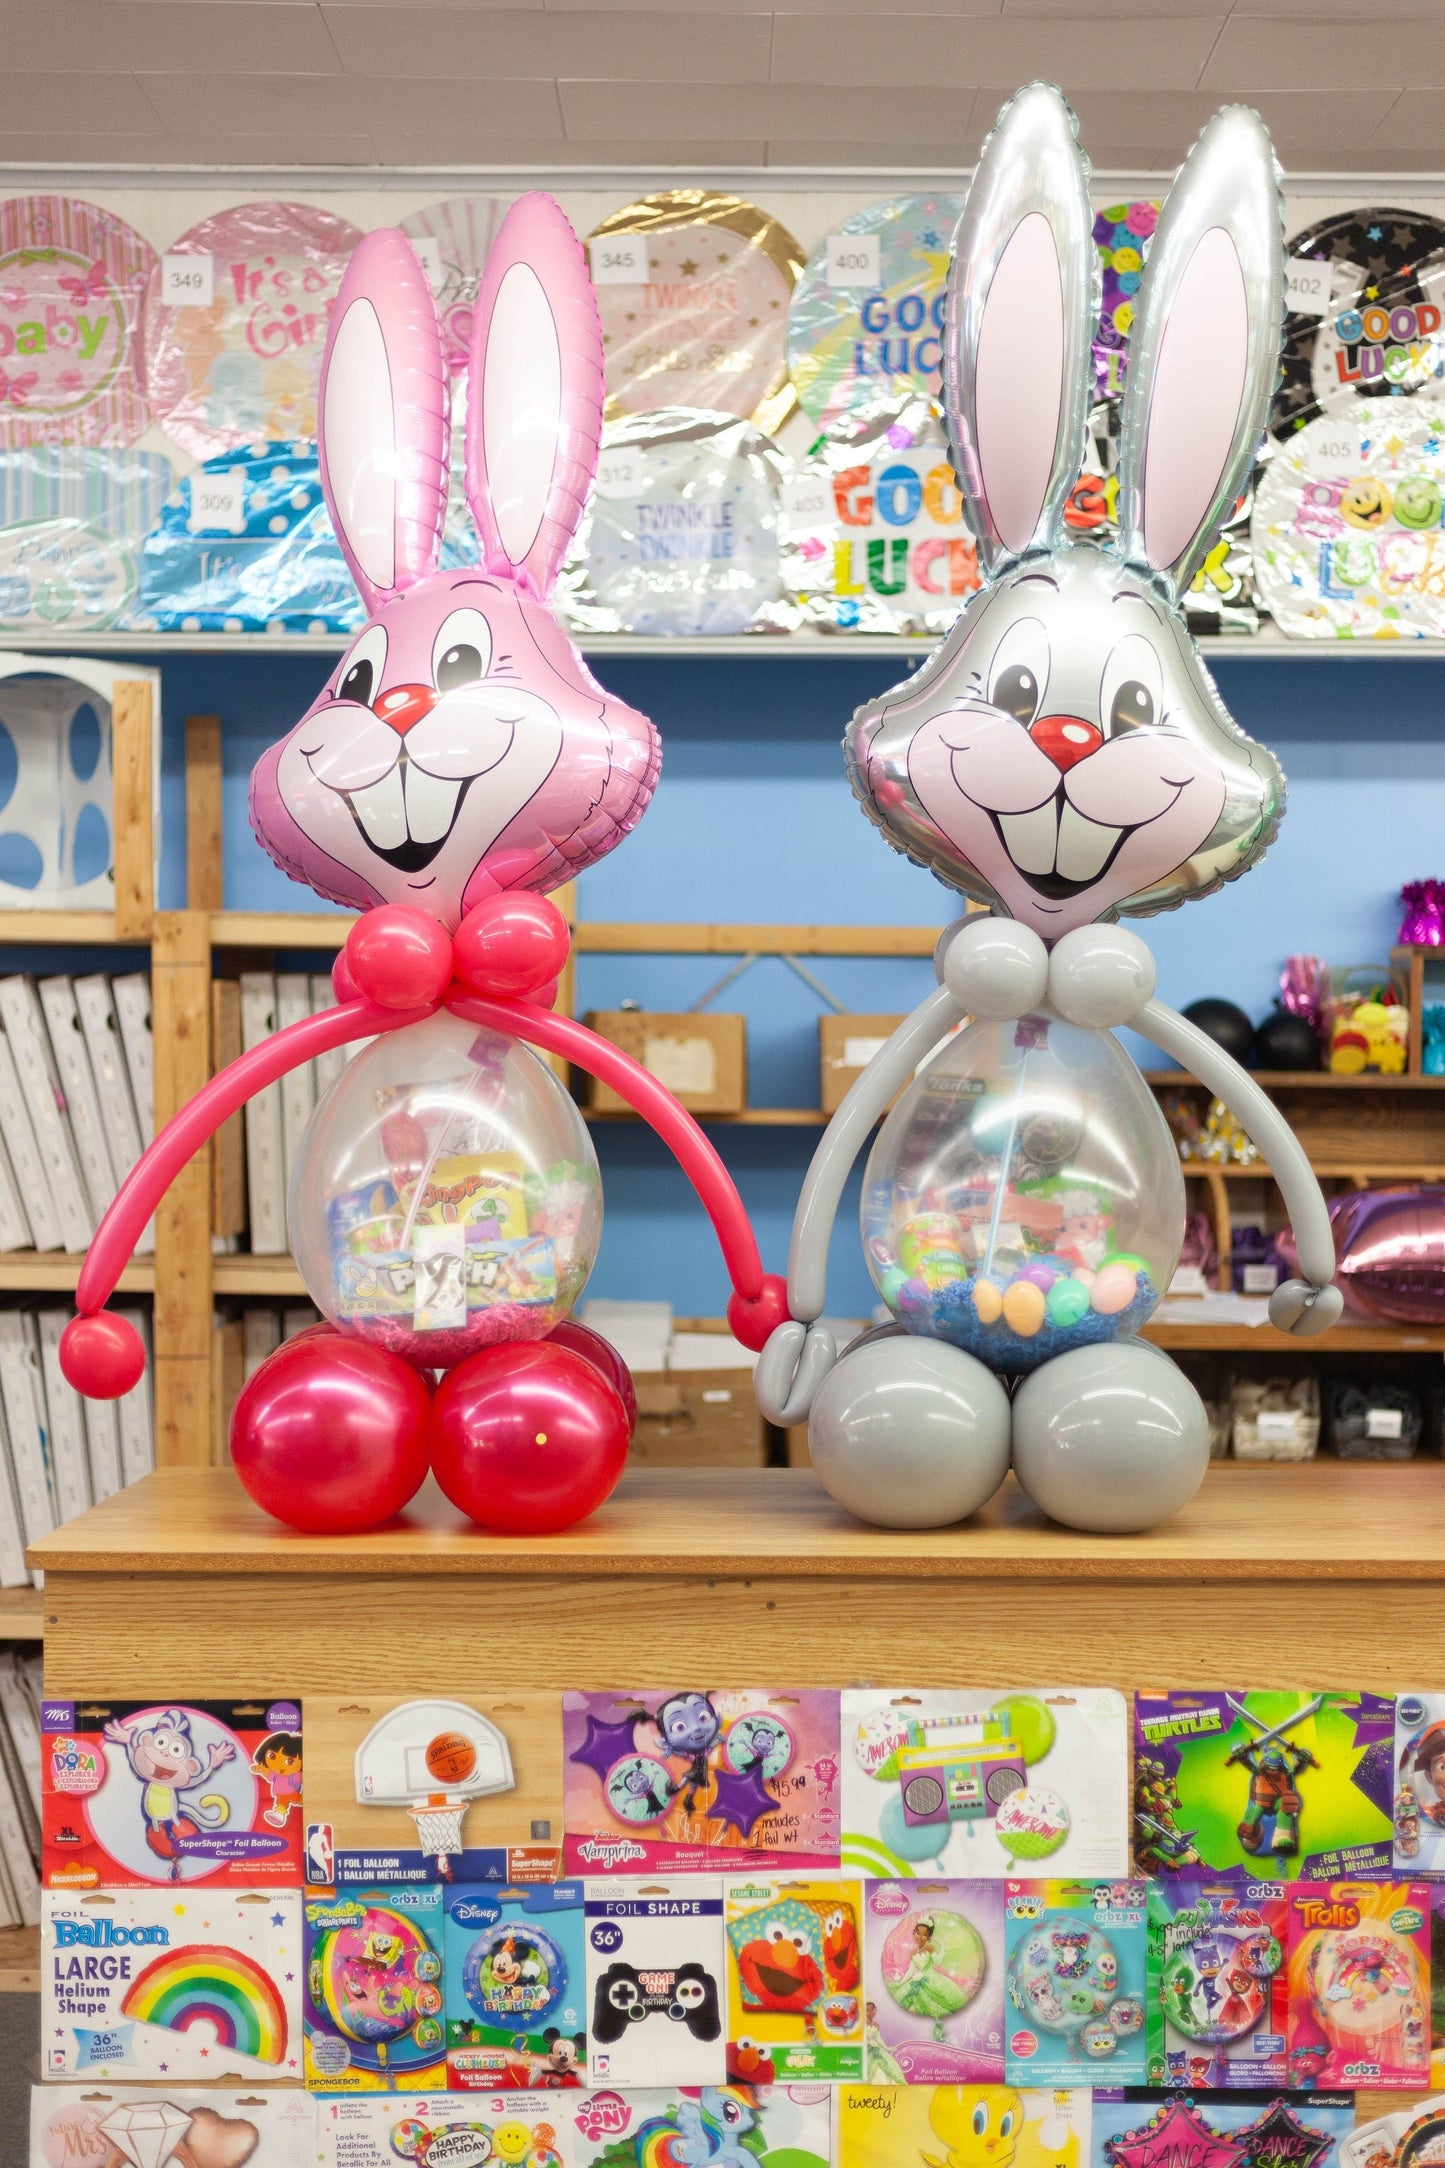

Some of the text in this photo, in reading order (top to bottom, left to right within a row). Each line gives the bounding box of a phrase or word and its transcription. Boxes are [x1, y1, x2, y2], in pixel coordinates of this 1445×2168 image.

[601, 252, 635, 269] 345
[834, 253, 869, 271] 400
[170, 272, 203, 289] 349
[230, 256, 293, 305] It's
[1289, 277, 1322, 295] 402
[1335, 304, 1442, 342] GOOD
[1319, 442, 1351, 458] 405
[600, 466, 633, 483] 312
[199, 494, 232, 512] 309
[270, 1712, 298, 1720] Balloon
[1141, 1715, 1222, 1741] TURTLES
[430, 1739, 467, 1760] SPALDING
[761, 1813, 800, 1829] includes
[1004, 1809, 1061, 1840] AWESOME
[234, 1839, 282, 1848] Foil Balloon
[578, 1843, 646, 1868] Vampirina
[675, 1851, 705, 1859] Bouquet
[1341, 1847, 1376, 1862] BALLOON
[343, 1859, 361, 1868] FOIL
[363, 1858, 399, 1868] BALLOON
[311, 1870, 325, 1881] NBA
[343, 1871, 374, 1880] BALLON
[376, 1868, 427, 1880] MÉTALLIQUE
[390, 1892, 438, 1905] orbz XL
[731, 1889, 771, 1898] SESAME STREET
[1247, 1883, 1285, 1898] orbz
[606, 1902, 701, 1915] FOIL SHAPE
[873, 1898, 909, 1912] Disney
[1008, 1897, 1044, 1908] BEANIE
[457, 1905, 499, 1923] Disney
[1127, 1911, 1142, 1922] XL
[1173, 1909, 1199, 1928] PJ
[1293, 1901, 1358, 1928] Trolls
[51, 1918, 170, 1949] Balloon
[53, 1955, 131, 1981] LARGE
[638, 1972, 676, 1984] GAME
[54, 1983, 111, 1998] Helium
[490, 1985, 544, 2001] HAPPY
[645, 1983, 670, 1995] ON!
[57, 1999, 107, 2018] Shape
[484, 1997, 548, 2012] BIRTHDAY
[89, 2051, 125, 2061] ENCLOSED
[90, 2044, 123, 2054] BALLOON
[1343, 2060, 1381, 2077] orbz
[308, 2079, 361, 2087] SPONGEBOB
[330, 2105, 338, 2120] 1
[415, 2101, 429, 2116] 2
[490, 2098, 505, 2113] 3
[848, 2092, 897, 2118] tweety!
[574, 2106, 632, 2139] PONY
[62, 2126, 107, 2158] Mrs
[335, 2133, 354, 2141] Look
[435, 2134, 476, 2150] HAPPY
[336, 2142, 376, 2150] Additional
[428, 2141, 487, 2162] BIRTHDAY
[1250, 2135, 1308, 2158] DANCE
[336, 2150, 382, 2160] Products By
[1140, 2143, 1215, 2168] DANCE
[337, 2159, 391, 2168] Betallic For All
